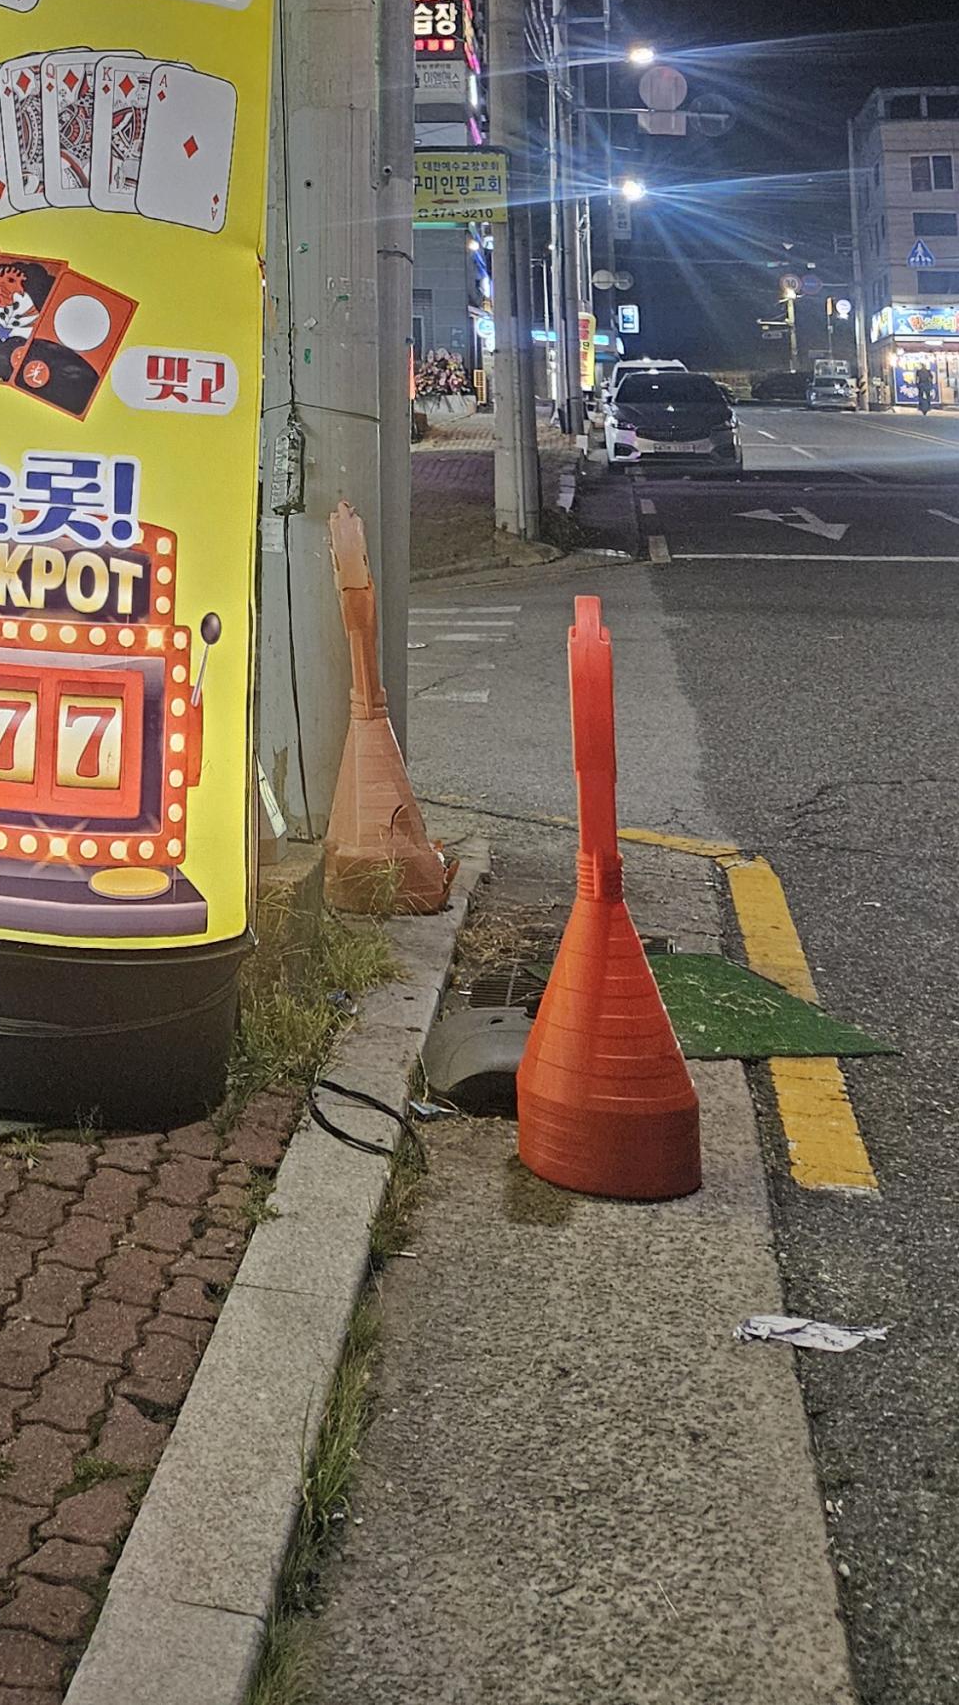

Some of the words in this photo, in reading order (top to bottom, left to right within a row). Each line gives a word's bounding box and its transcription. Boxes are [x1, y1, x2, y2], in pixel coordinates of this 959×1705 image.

[413, 2, 458, 36] 습장
[102, 66, 113, 82] K
[159, 74, 169, 89] A
[145, 354, 227, 406] 맞고
